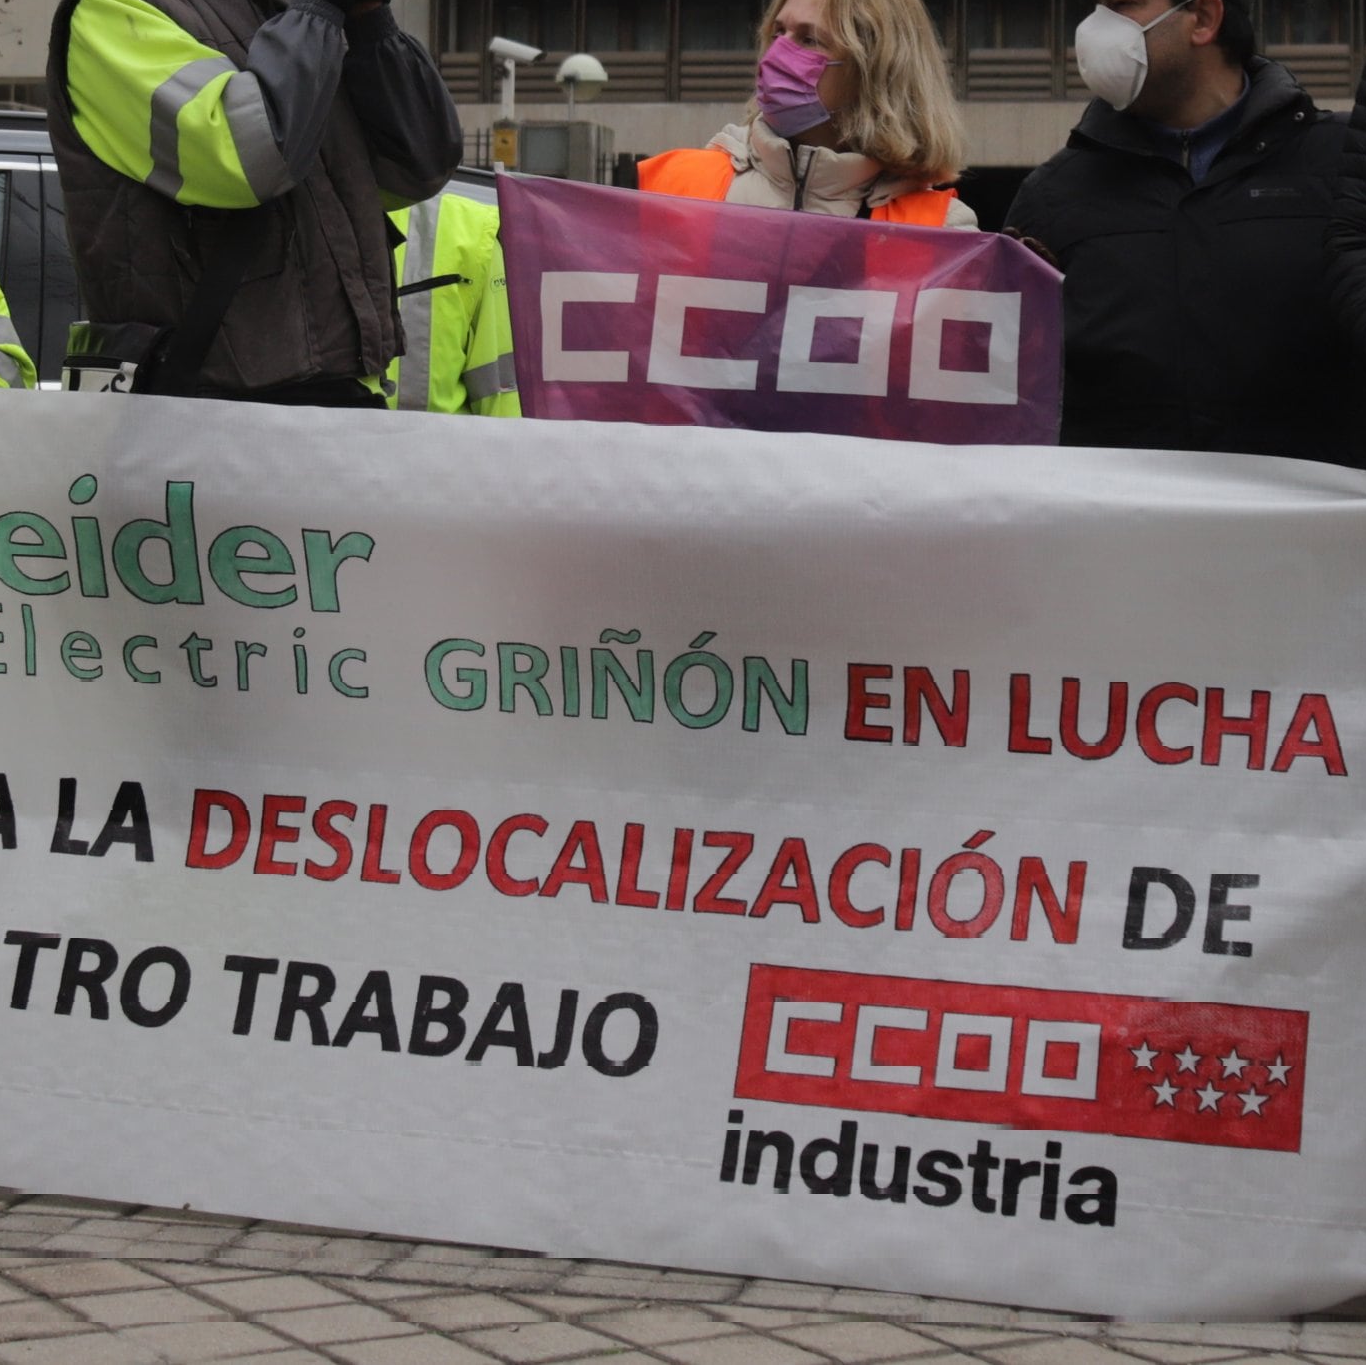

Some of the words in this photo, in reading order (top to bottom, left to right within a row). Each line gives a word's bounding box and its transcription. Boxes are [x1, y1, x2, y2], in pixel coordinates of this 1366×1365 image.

[540, 271, 1022, 404] CCOO
[424, 627, 809, 737] GRIÑÓN
[844, 663, 970, 748] EN
[1007, 674, 1349, 777] LUCHA
[48, 777, 155, 864] LA
[185, 788, 1088, 945] DESLOCALIZACIÓN
[1121, 867, 1260, 958] DE
[222, 954, 660, 1078] TRABAJO
[765, 1000, 1102, 1101] CCOO
[719, 1110, 1119, 1227] industria
